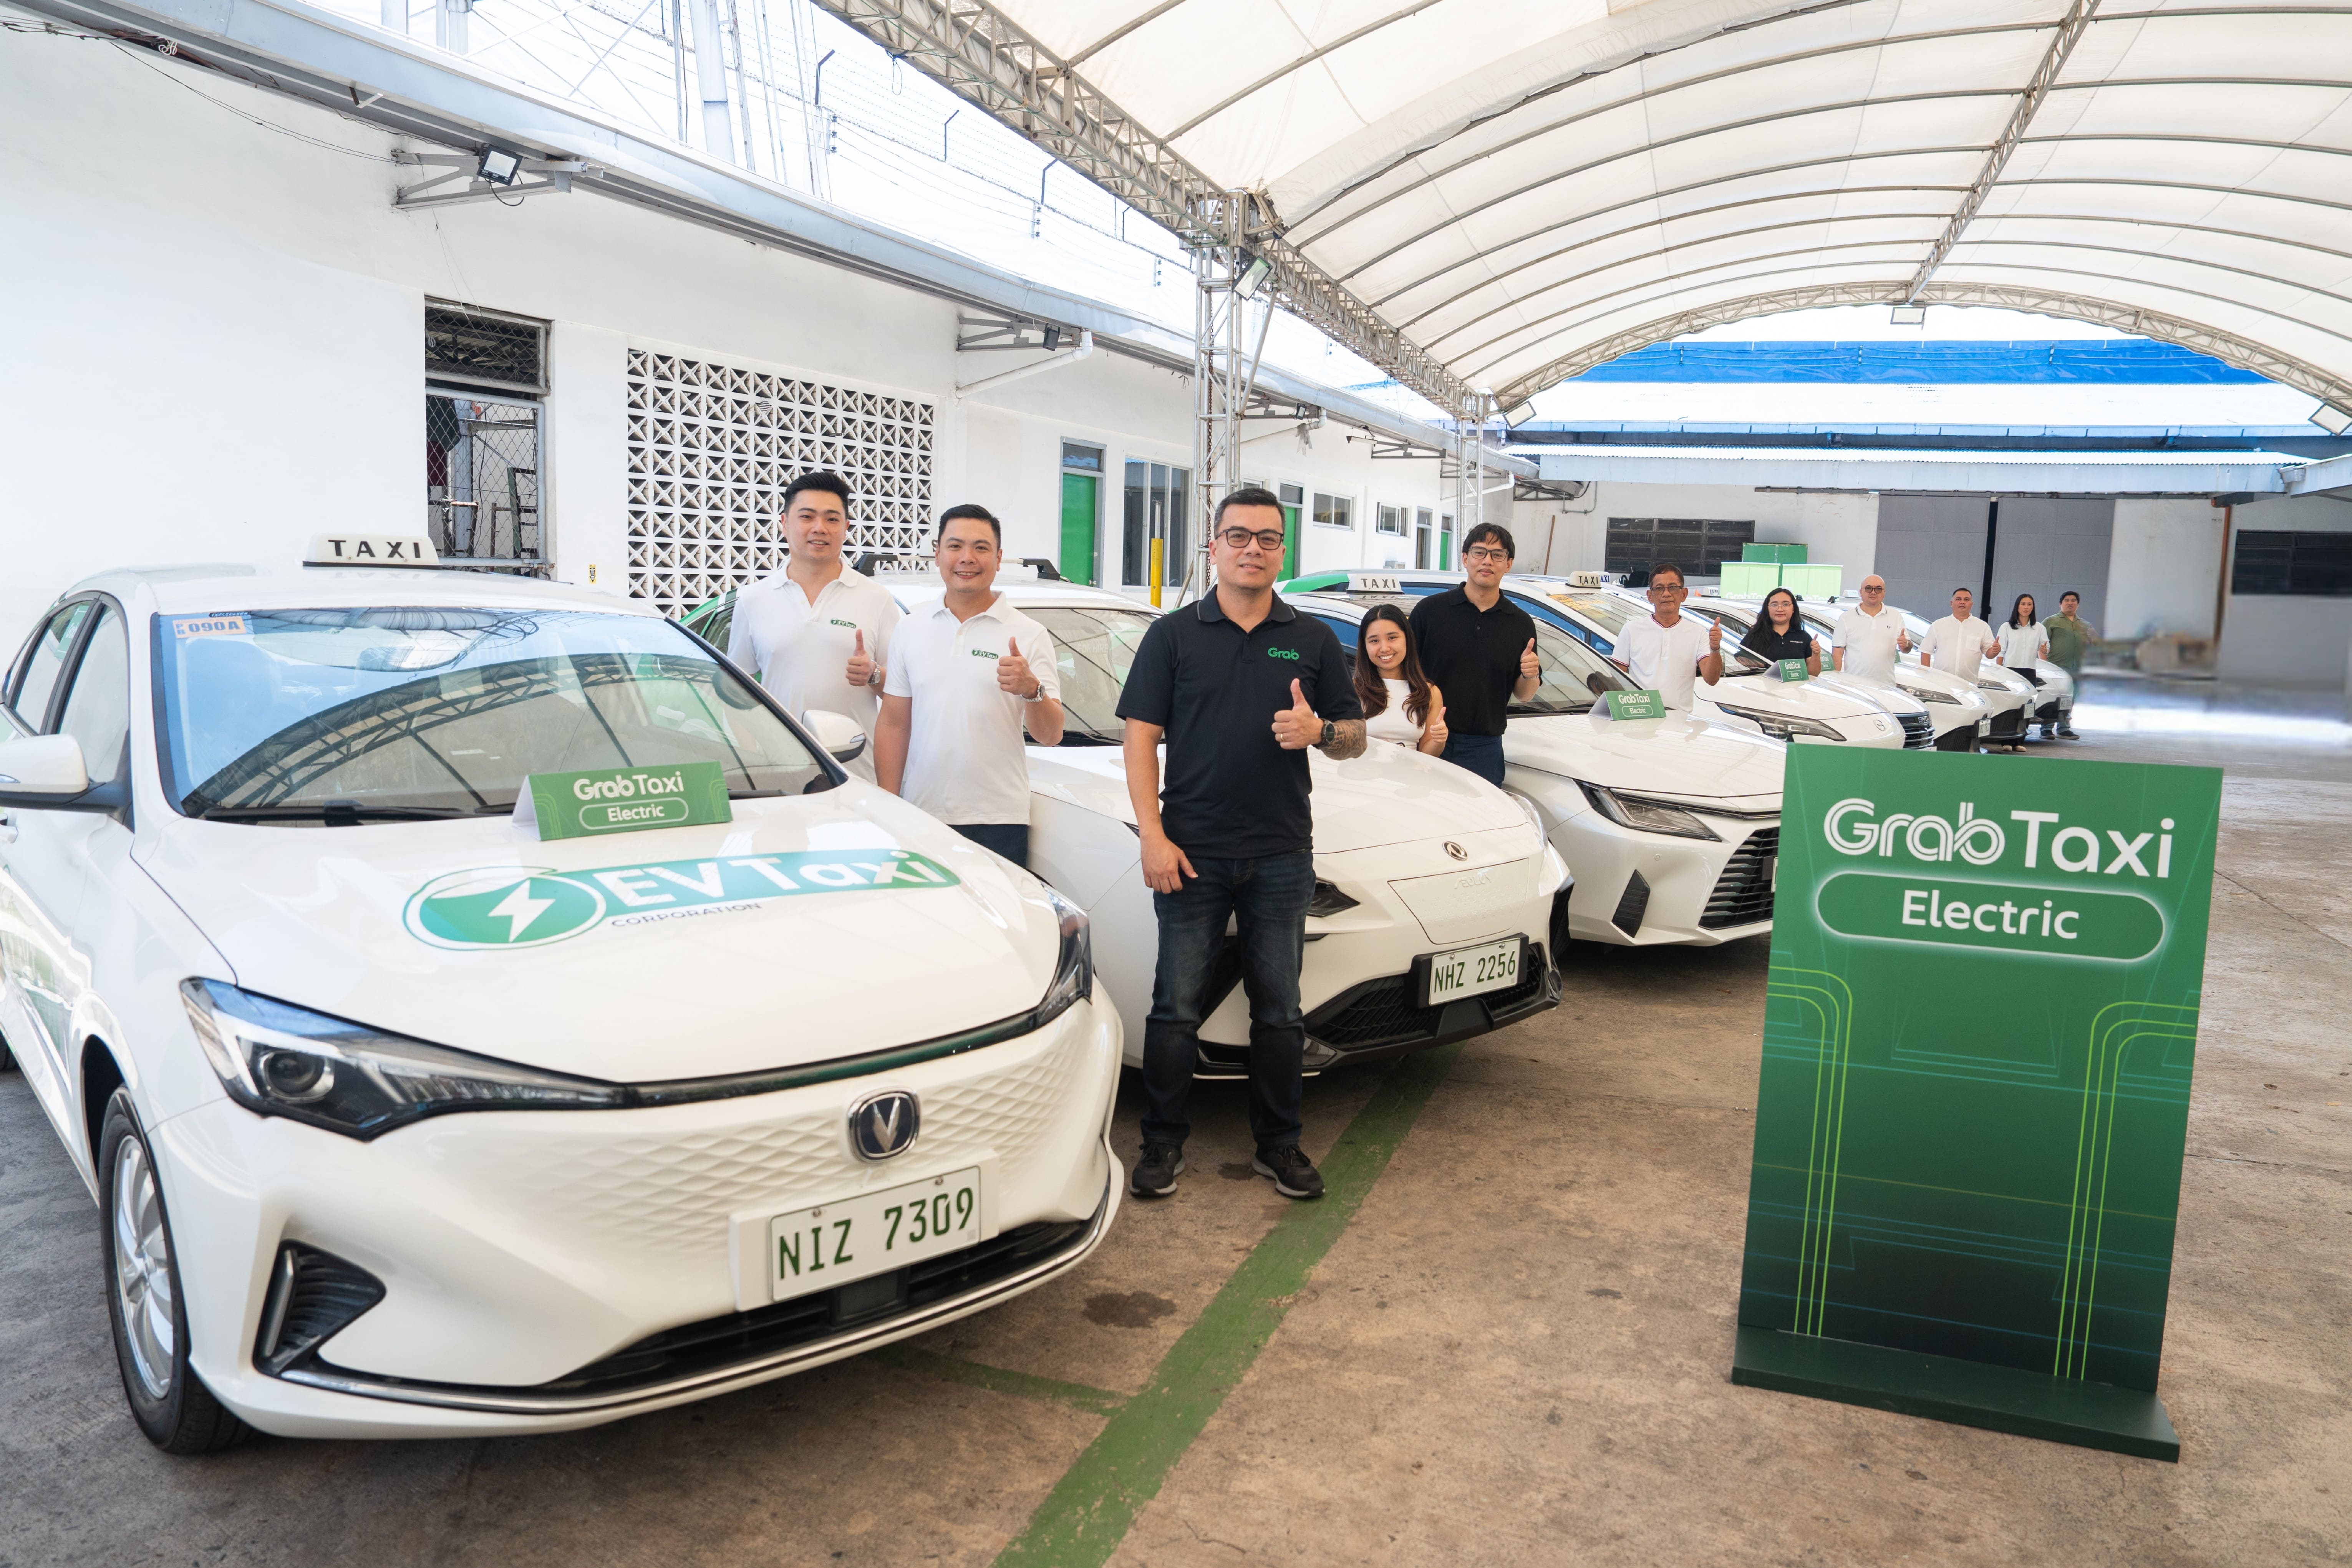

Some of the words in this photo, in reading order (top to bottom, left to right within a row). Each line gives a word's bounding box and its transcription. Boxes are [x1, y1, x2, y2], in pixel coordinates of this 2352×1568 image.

[328, 540, 421, 559] TAXI
[1361, 578, 1396, 588] TAXI
[1578, 576, 1598, 584] TAXI
[980, 651, 997, 659] EVTaxi
[1268, 647, 1299, 660] Grab
[1785, 661, 1801, 670] GrabTaxi
[1618, 693, 1650, 704] GrabTaxi
[573, 771, 685, 801] GrabTaxi
[607, 804, 665, 822] Electric
[1823, 798, 2175, 878] GrabTaxi
[610, 903, 762, 927] CORPORATION
[1902, 890, 2079, 939] Electric
[1434, 961, 1465, 993] NHZ
[1477, 951, 1515, 984] 2256
[779, 1218, 853, 1280] NIZ
[884, 1187, 973, 1251] 7309
